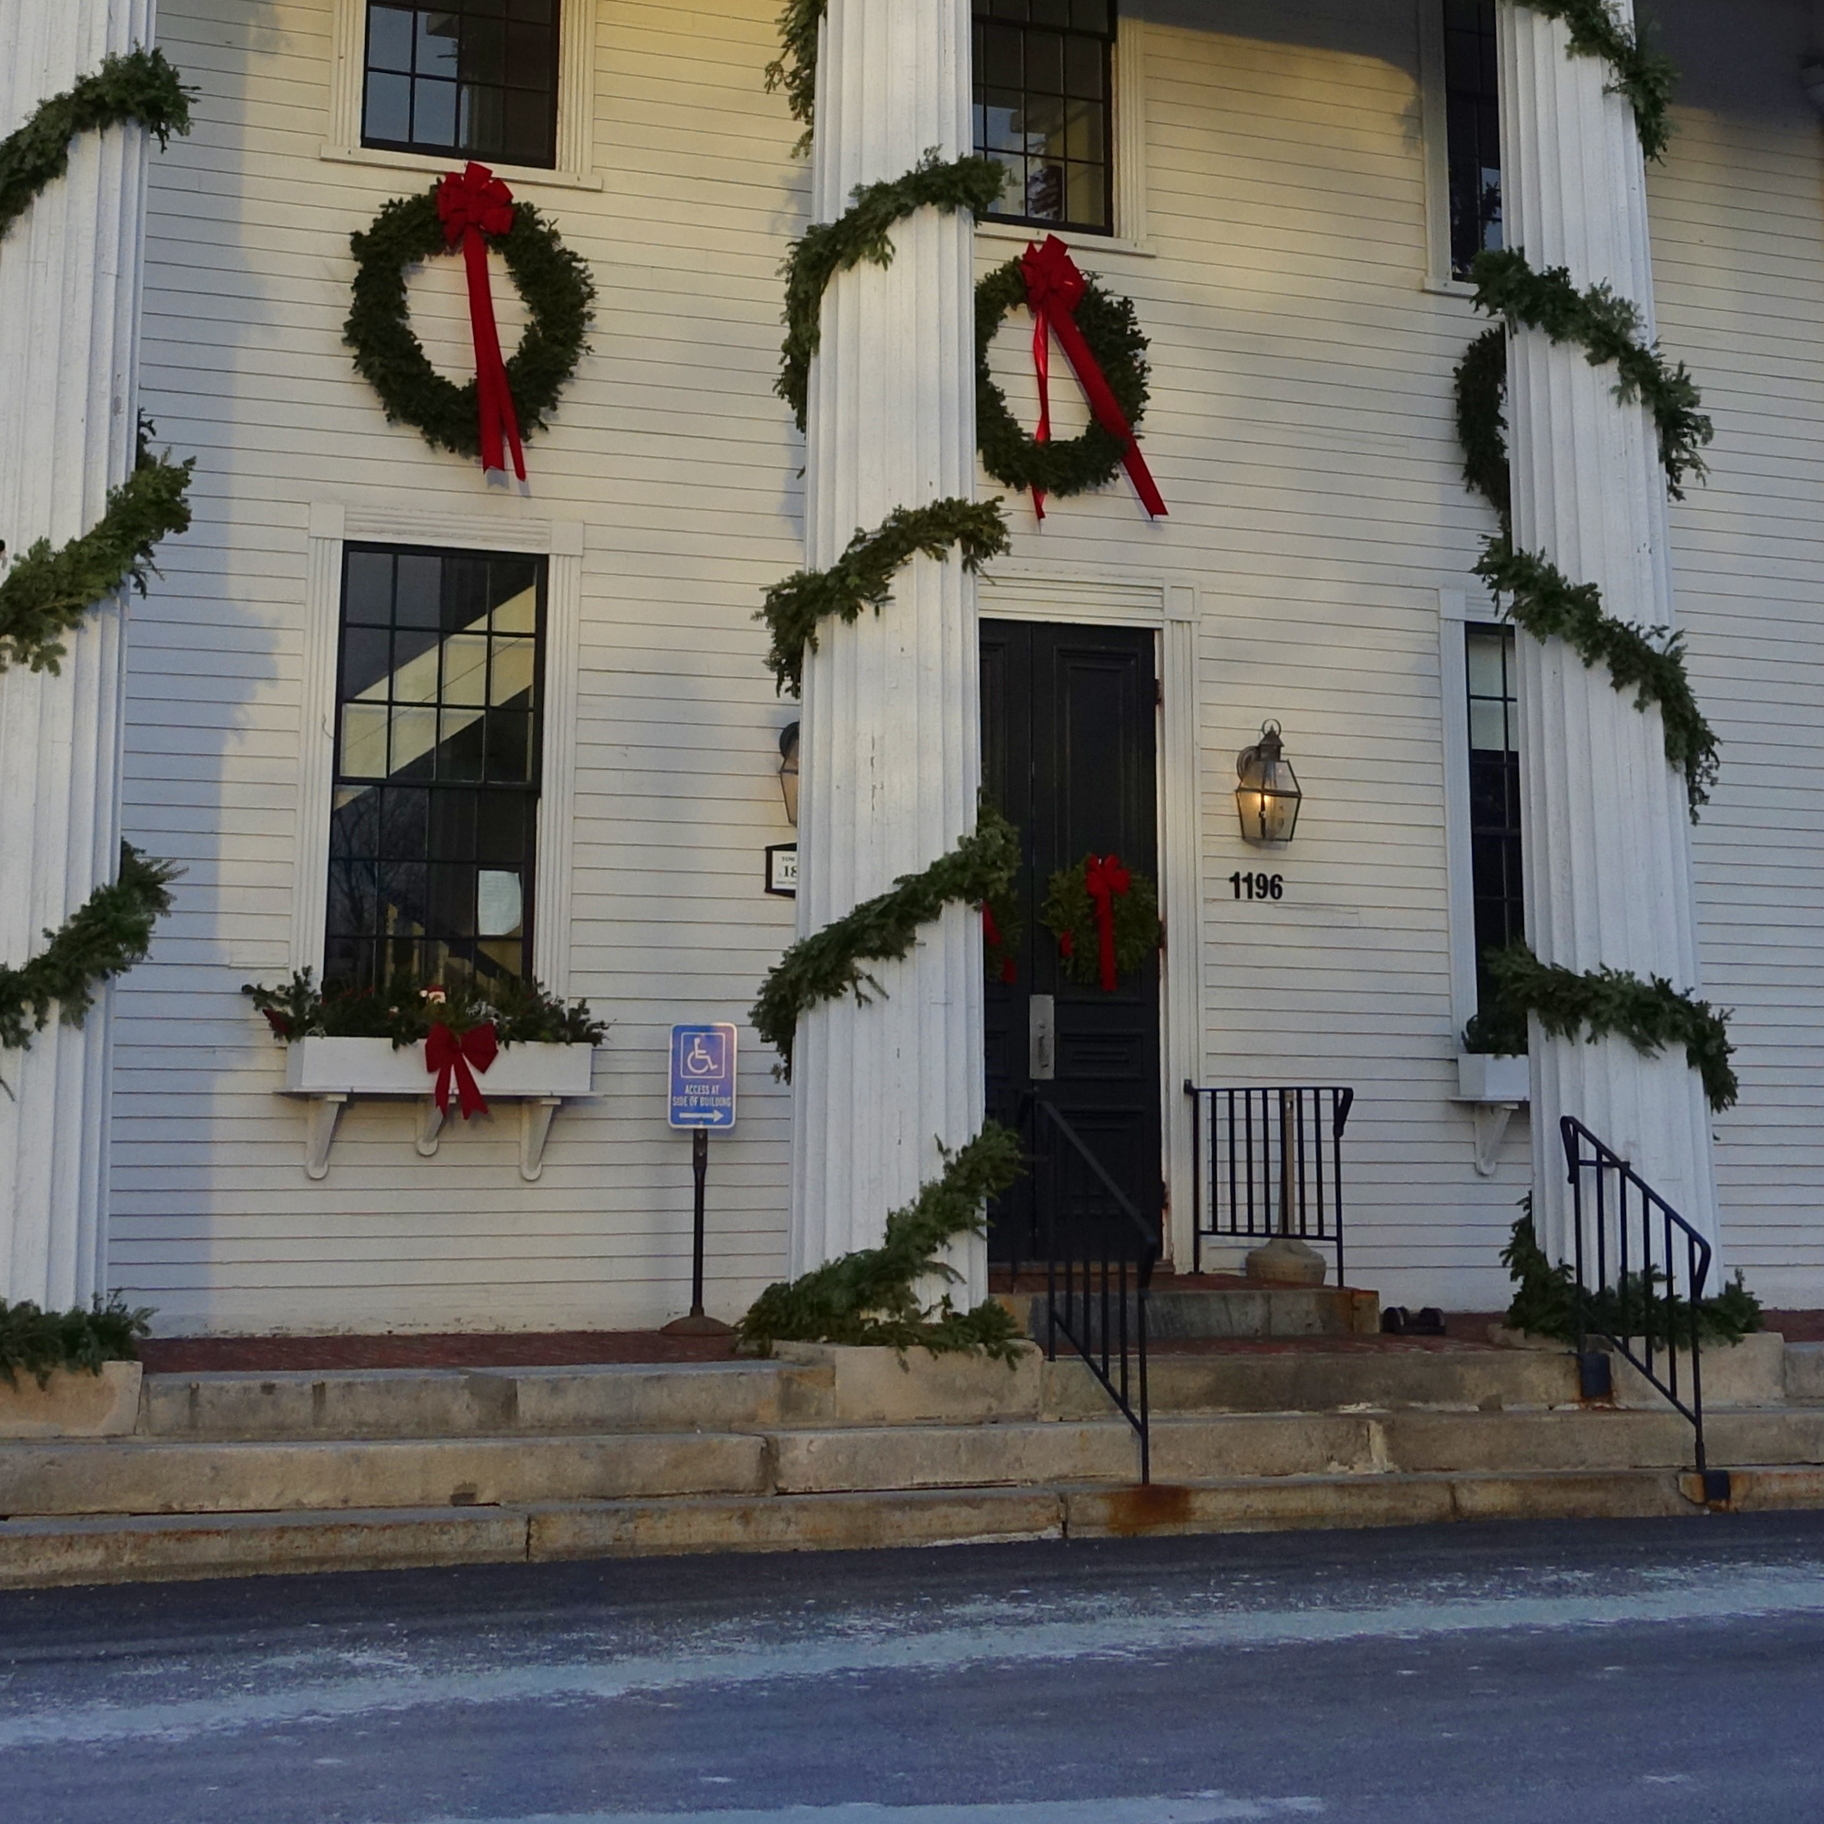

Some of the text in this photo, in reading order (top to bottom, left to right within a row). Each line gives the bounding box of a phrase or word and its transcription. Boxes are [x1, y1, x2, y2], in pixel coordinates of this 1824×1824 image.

[1229, 871, 1283, 900] 1196
[684, 1084, 720, 1095] ACCESS AT
[672, 1096, 732, 1107] SIDE OF BUILDING
